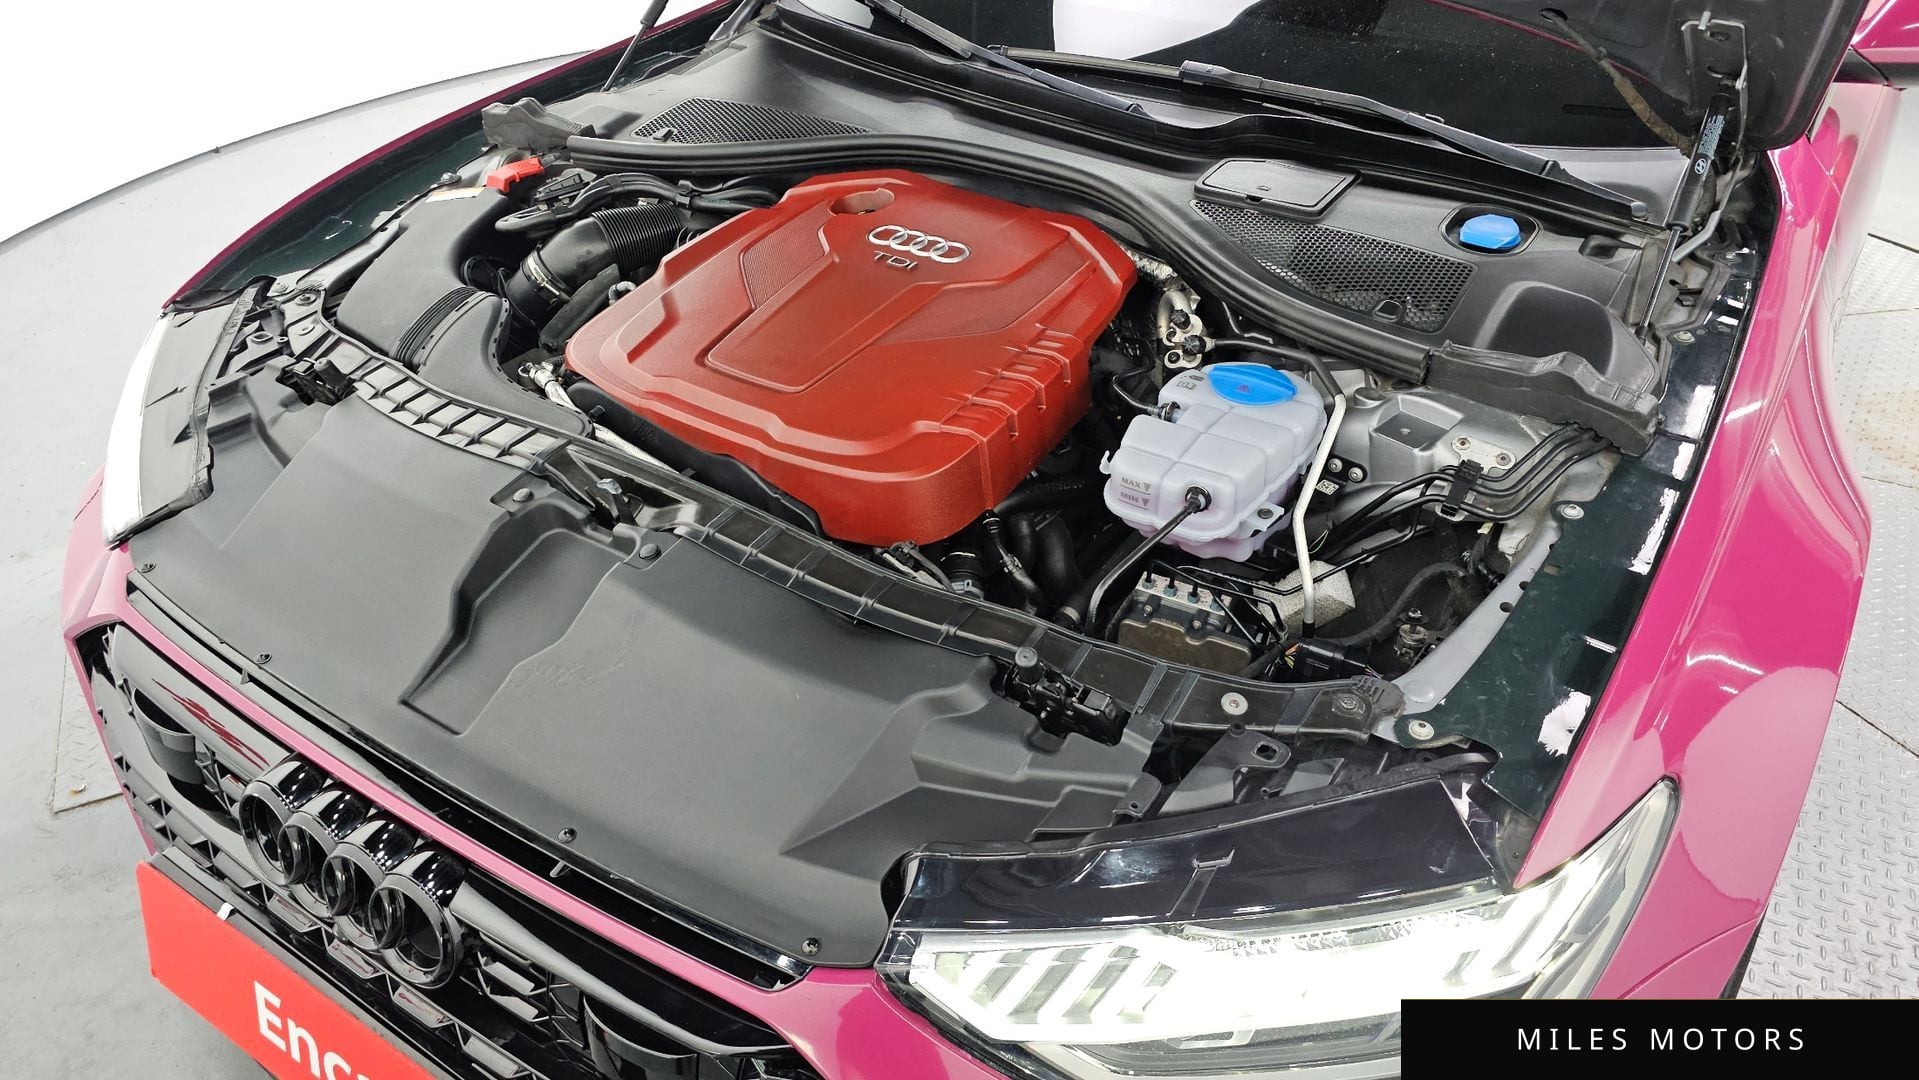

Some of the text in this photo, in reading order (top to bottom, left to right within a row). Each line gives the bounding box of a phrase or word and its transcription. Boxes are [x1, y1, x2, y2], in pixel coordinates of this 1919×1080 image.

[874, 250, 918, 271] TDI
[1121, 476, 1141, 489] MAX
[1120, 491, 1139, 503] MIN
[254, 980, 370, 1080] Enc
